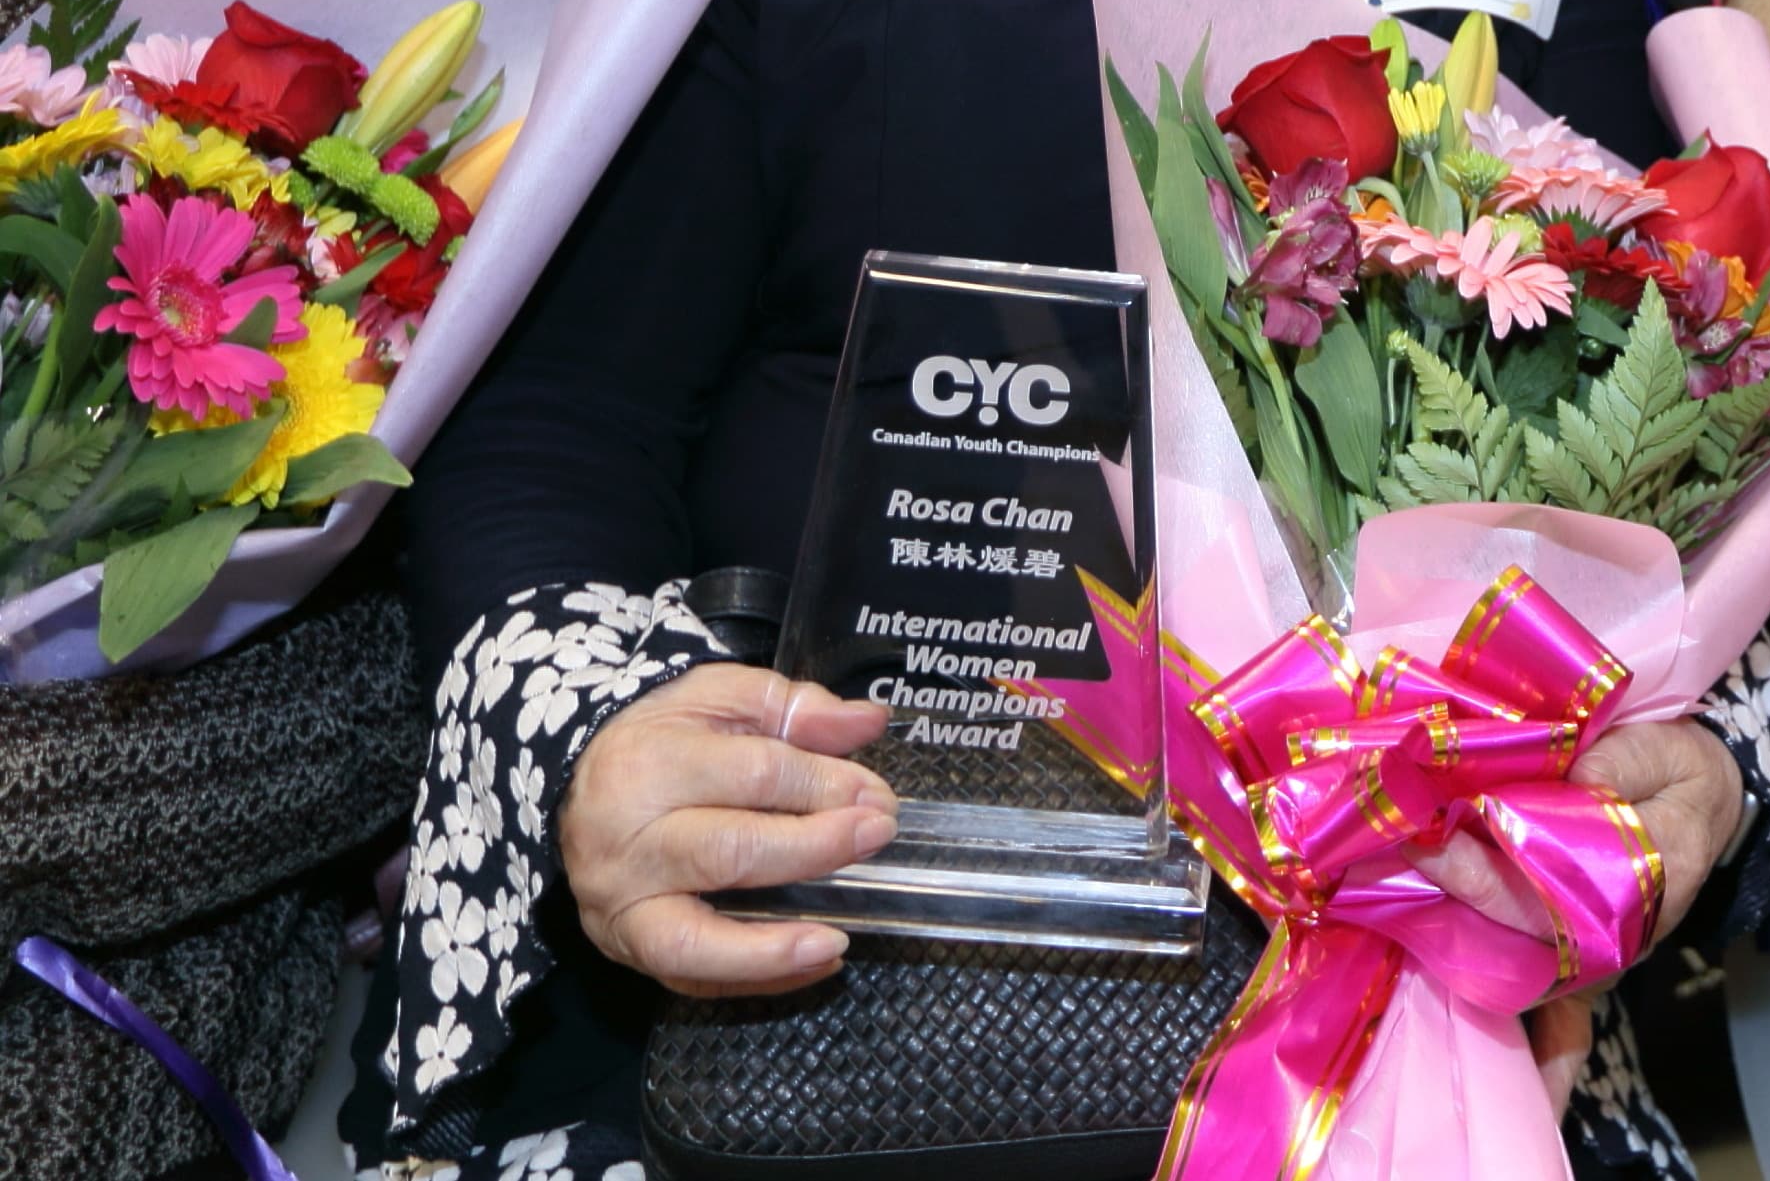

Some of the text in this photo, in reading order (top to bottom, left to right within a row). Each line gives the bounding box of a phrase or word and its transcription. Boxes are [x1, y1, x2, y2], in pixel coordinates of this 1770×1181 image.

[911, 354, 1071, 427] CYC
[872, 427, 1101, 463] Canadian Youth Champions
[886, 488, 1074, 533] Rosa Chan
[855, 604, 1093, 652] International
[905, 643, 1037, 682] Women
[867, 676, 1067, 720] Champions
[905, 714, 1024, 751] Award
